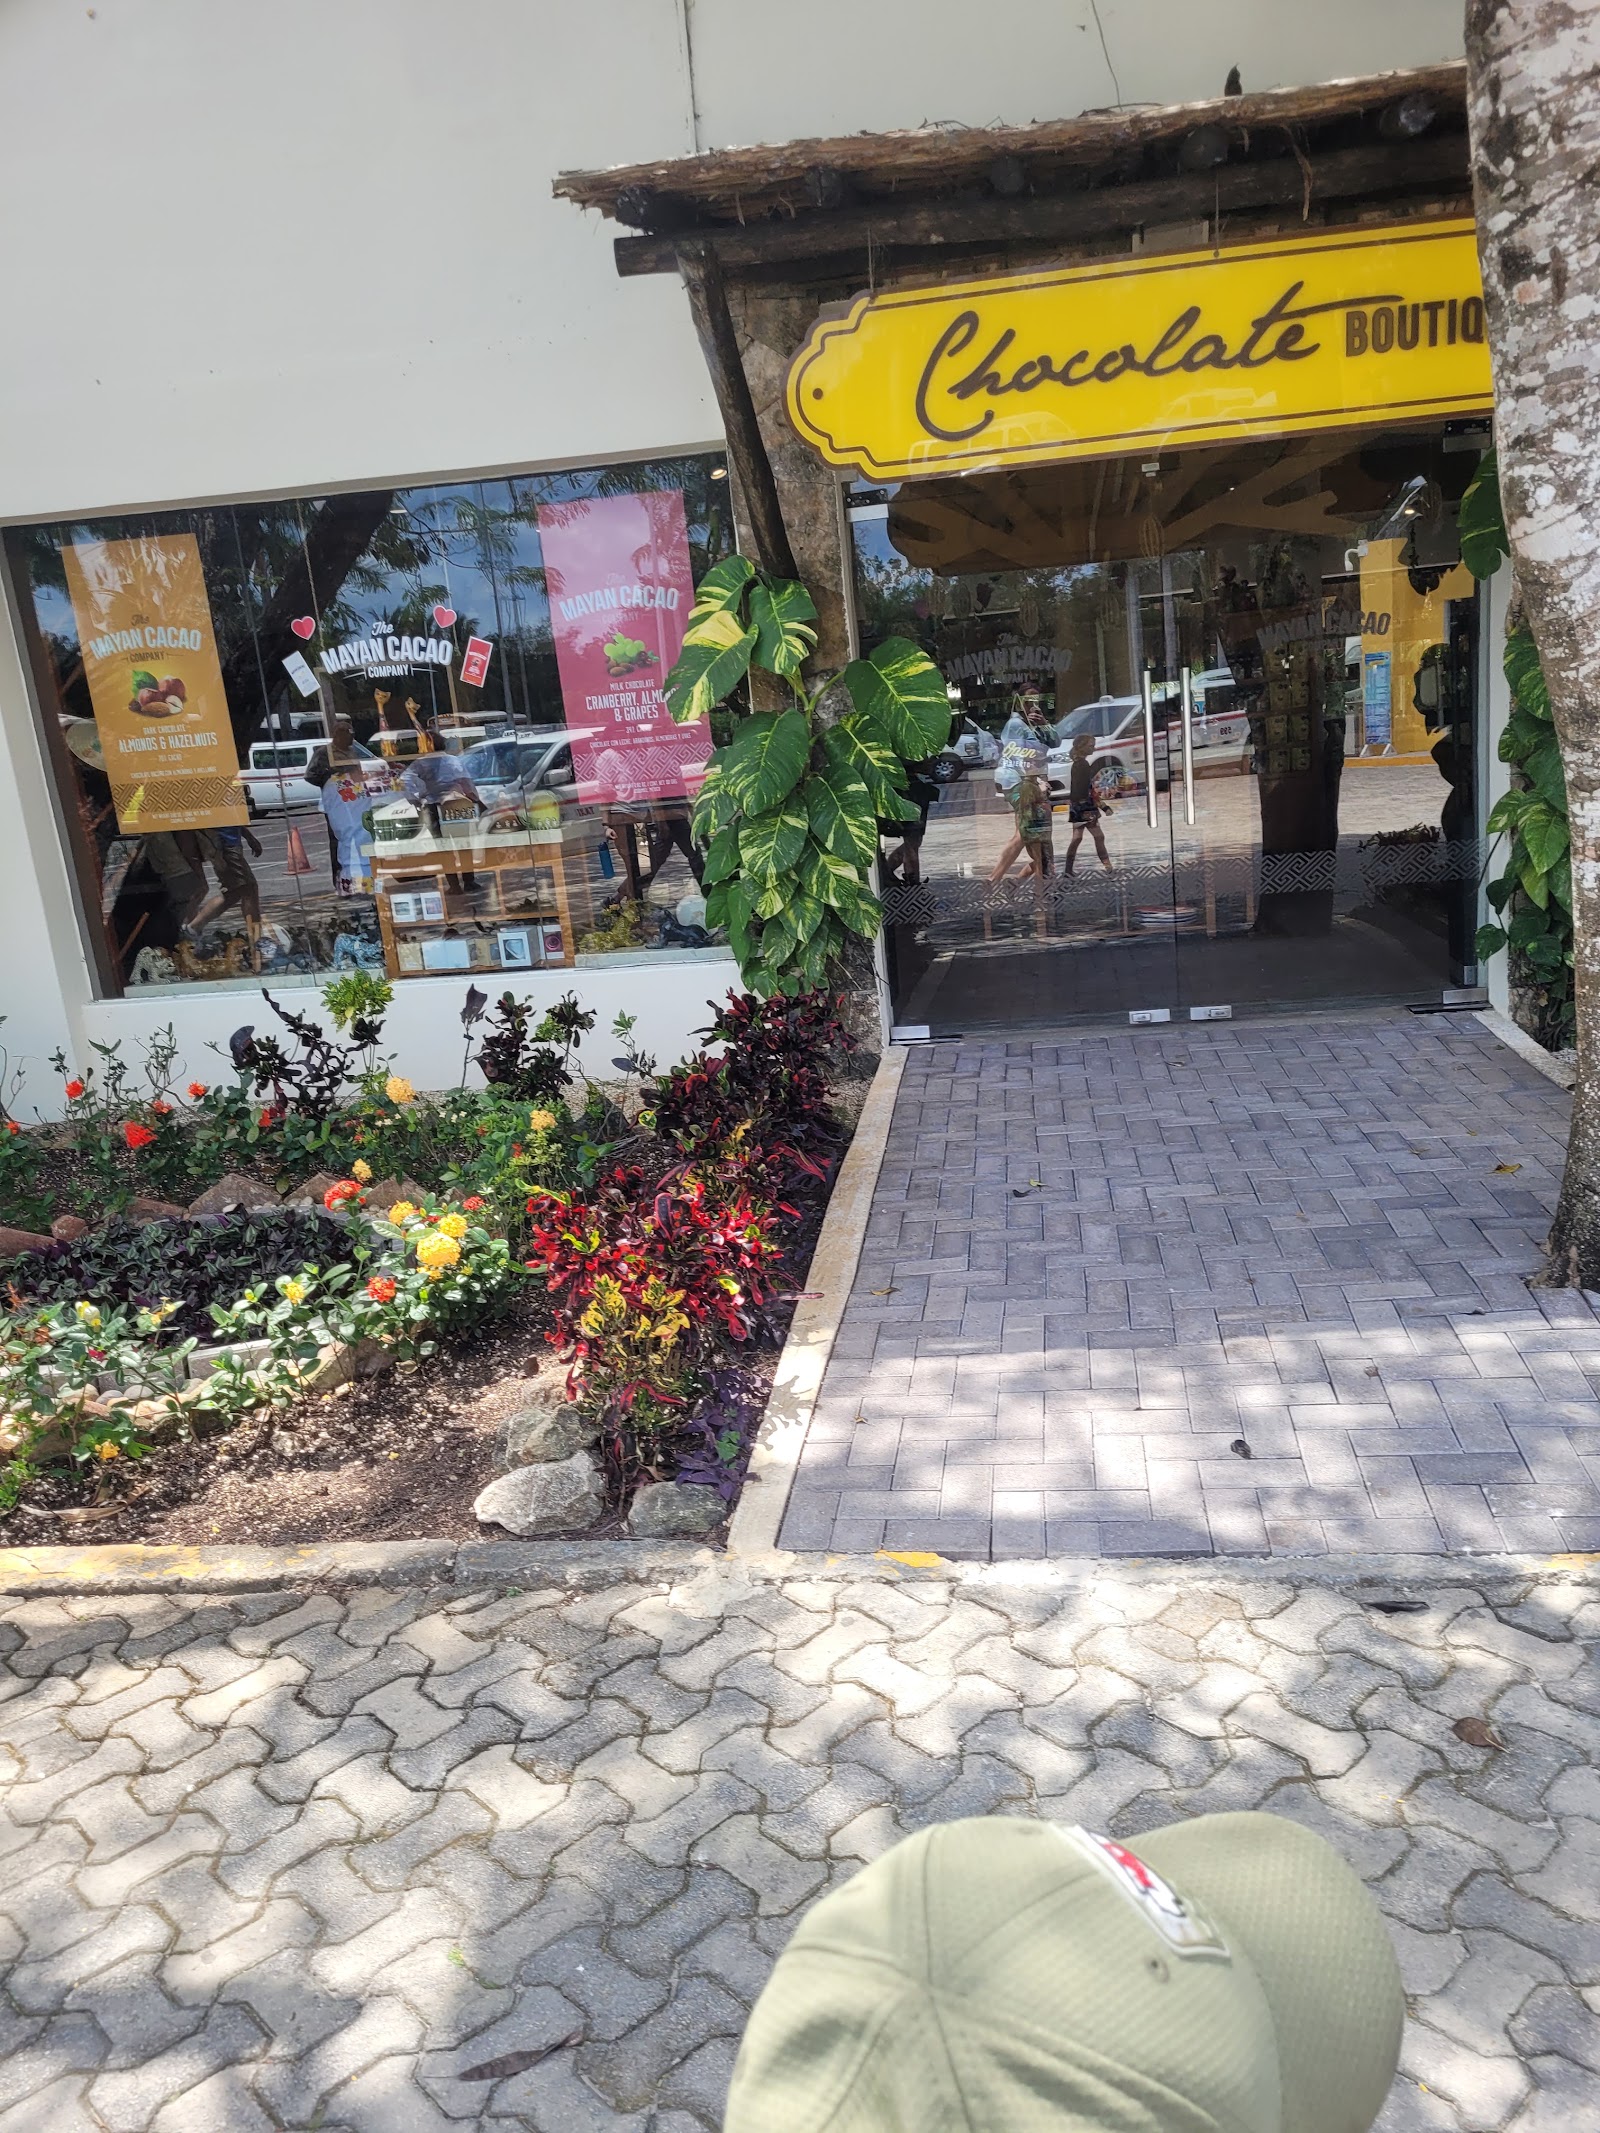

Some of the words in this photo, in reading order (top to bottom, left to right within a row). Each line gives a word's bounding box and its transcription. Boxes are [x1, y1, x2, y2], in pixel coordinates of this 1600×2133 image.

[915, 281, 1404, 441] Chocolate
[1346, 296, 1484, 357] BOUTIQ
[559, 587, 618, 621] MAYAN
[619, 585, 679, 610] CACAO
[371, 621, 395, 636] The
[89, 628, 144, 660] MAYAN
[144, 626, 202, 651] CACAO
[129, 651, 165, 663] COMPANY
[319, 637, 385, 675] MAYAN
[386, 636, 454, 666] CACAO
[367, 664, 410, 679] COMPANY
[609, 682, 624, 691] MILK
[625, 679, 655, 689] CHOCOLATE
[614, 708, 622, 722] &
[624, 704, 659, 721] GRAPES
[119, 737, 158, 753] ALMONDS
[168, 732, 218, 749] HAZELNUTS
[1002, 741, 1037, 759] Open
